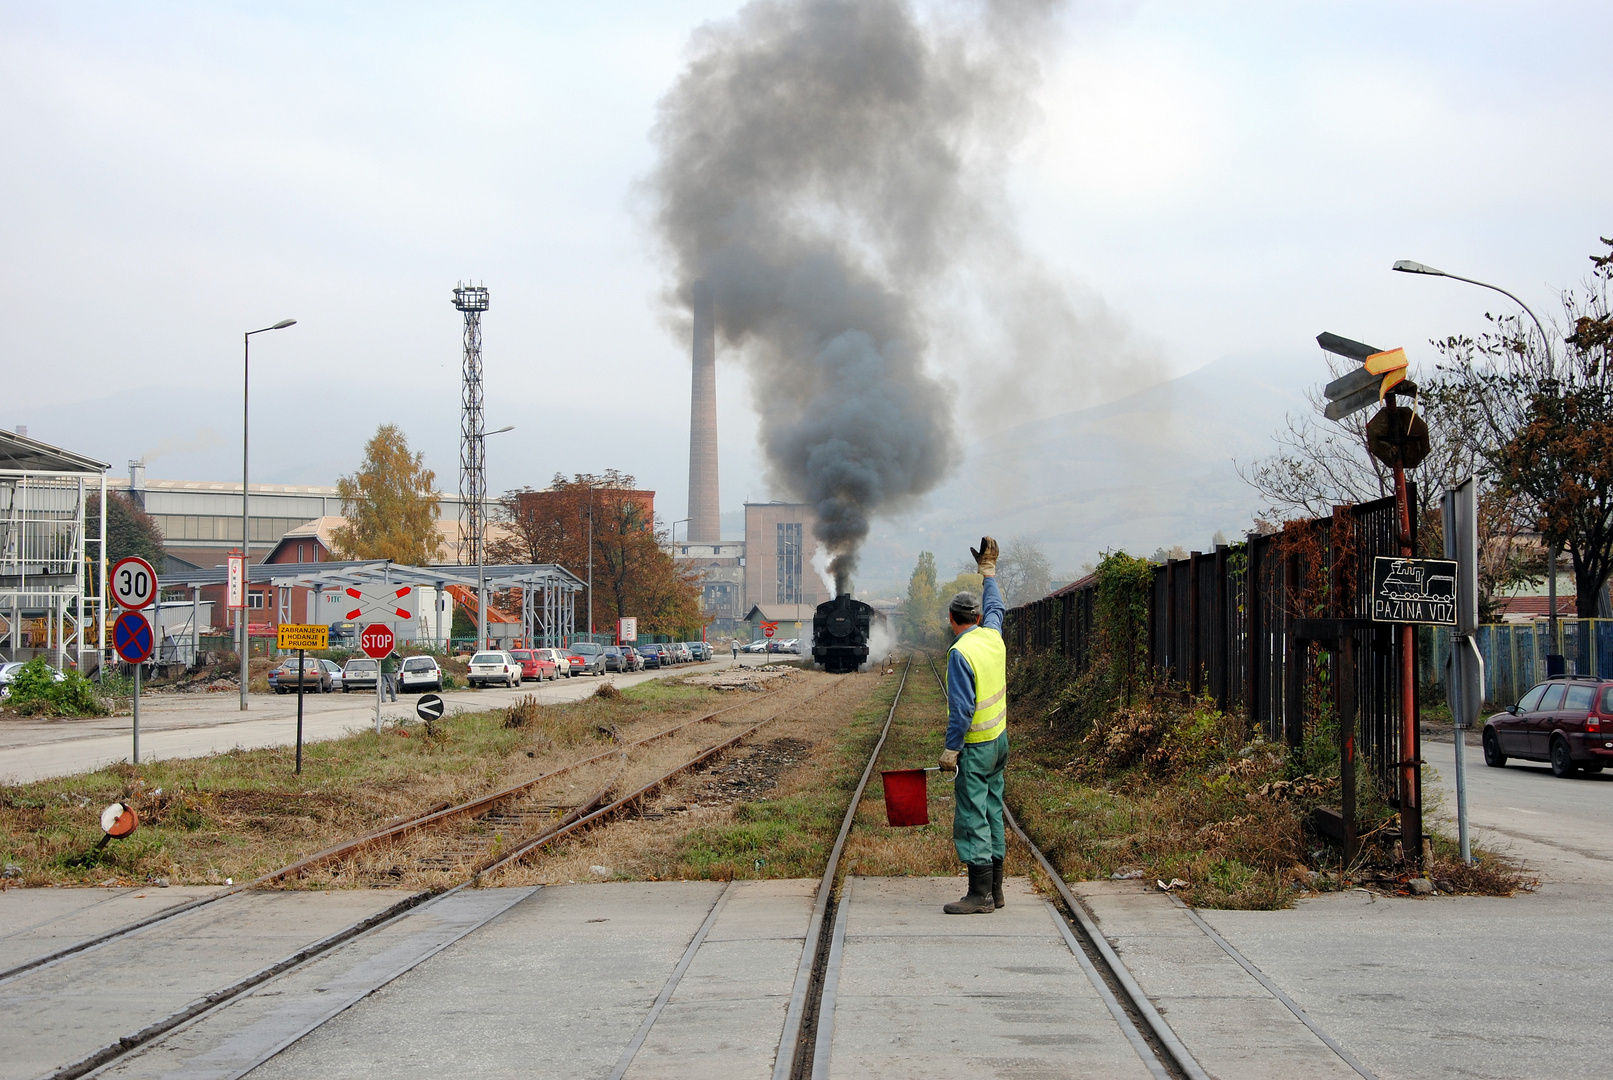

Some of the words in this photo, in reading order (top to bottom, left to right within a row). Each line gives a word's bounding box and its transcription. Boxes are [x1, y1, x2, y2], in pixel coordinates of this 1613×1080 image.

[120, 570, 147, 598] 30
[1429, 603, 1454, 622] VOZ
[362, 634, 392, 648] STOP
